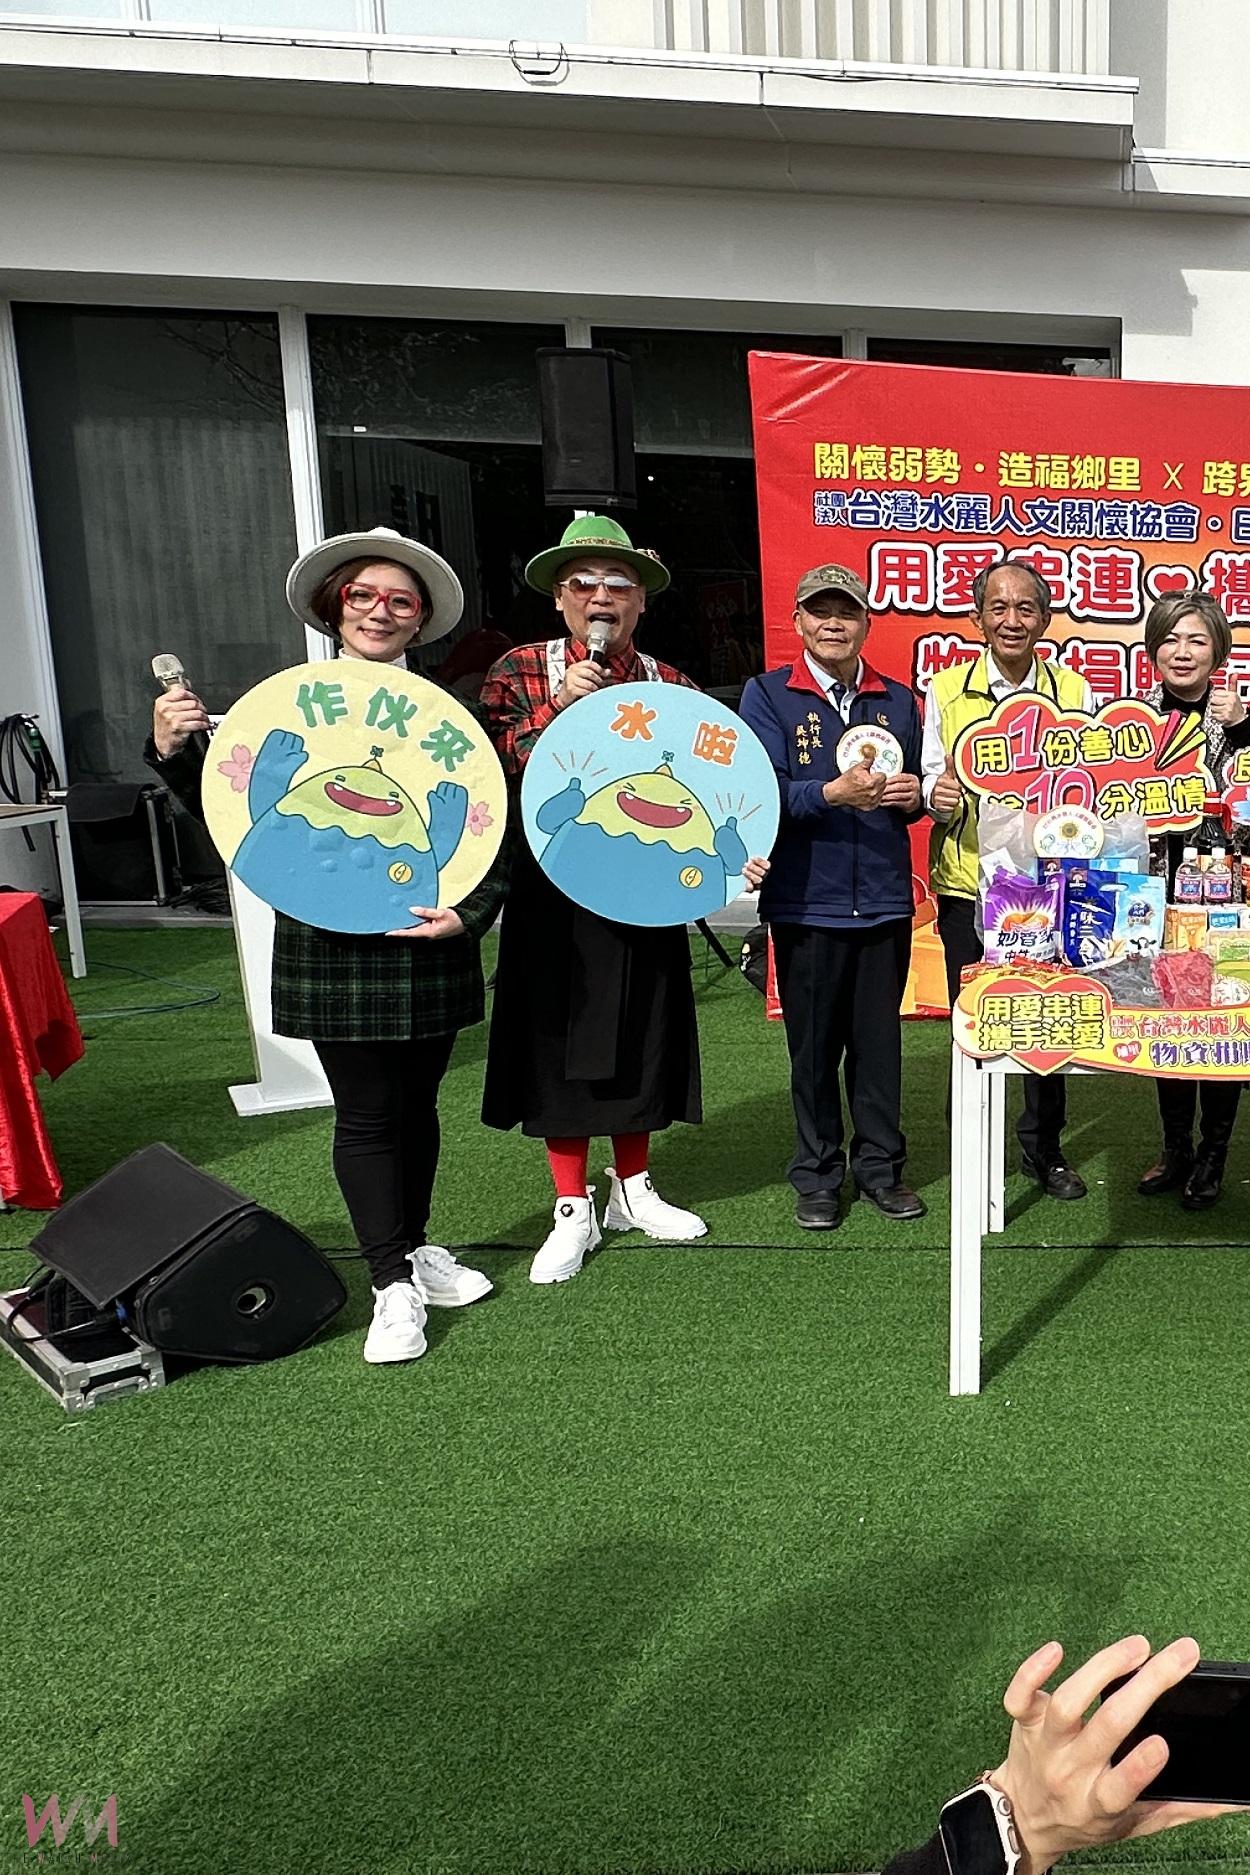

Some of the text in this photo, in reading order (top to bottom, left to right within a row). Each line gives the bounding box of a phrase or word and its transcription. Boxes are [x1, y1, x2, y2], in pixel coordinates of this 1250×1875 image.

[974, 705, 1150, 775] 用1份善心
[980, 993, 1104, 1022] 用愛串連
[979, 1022, 1105, 1052] 攜手送愛
